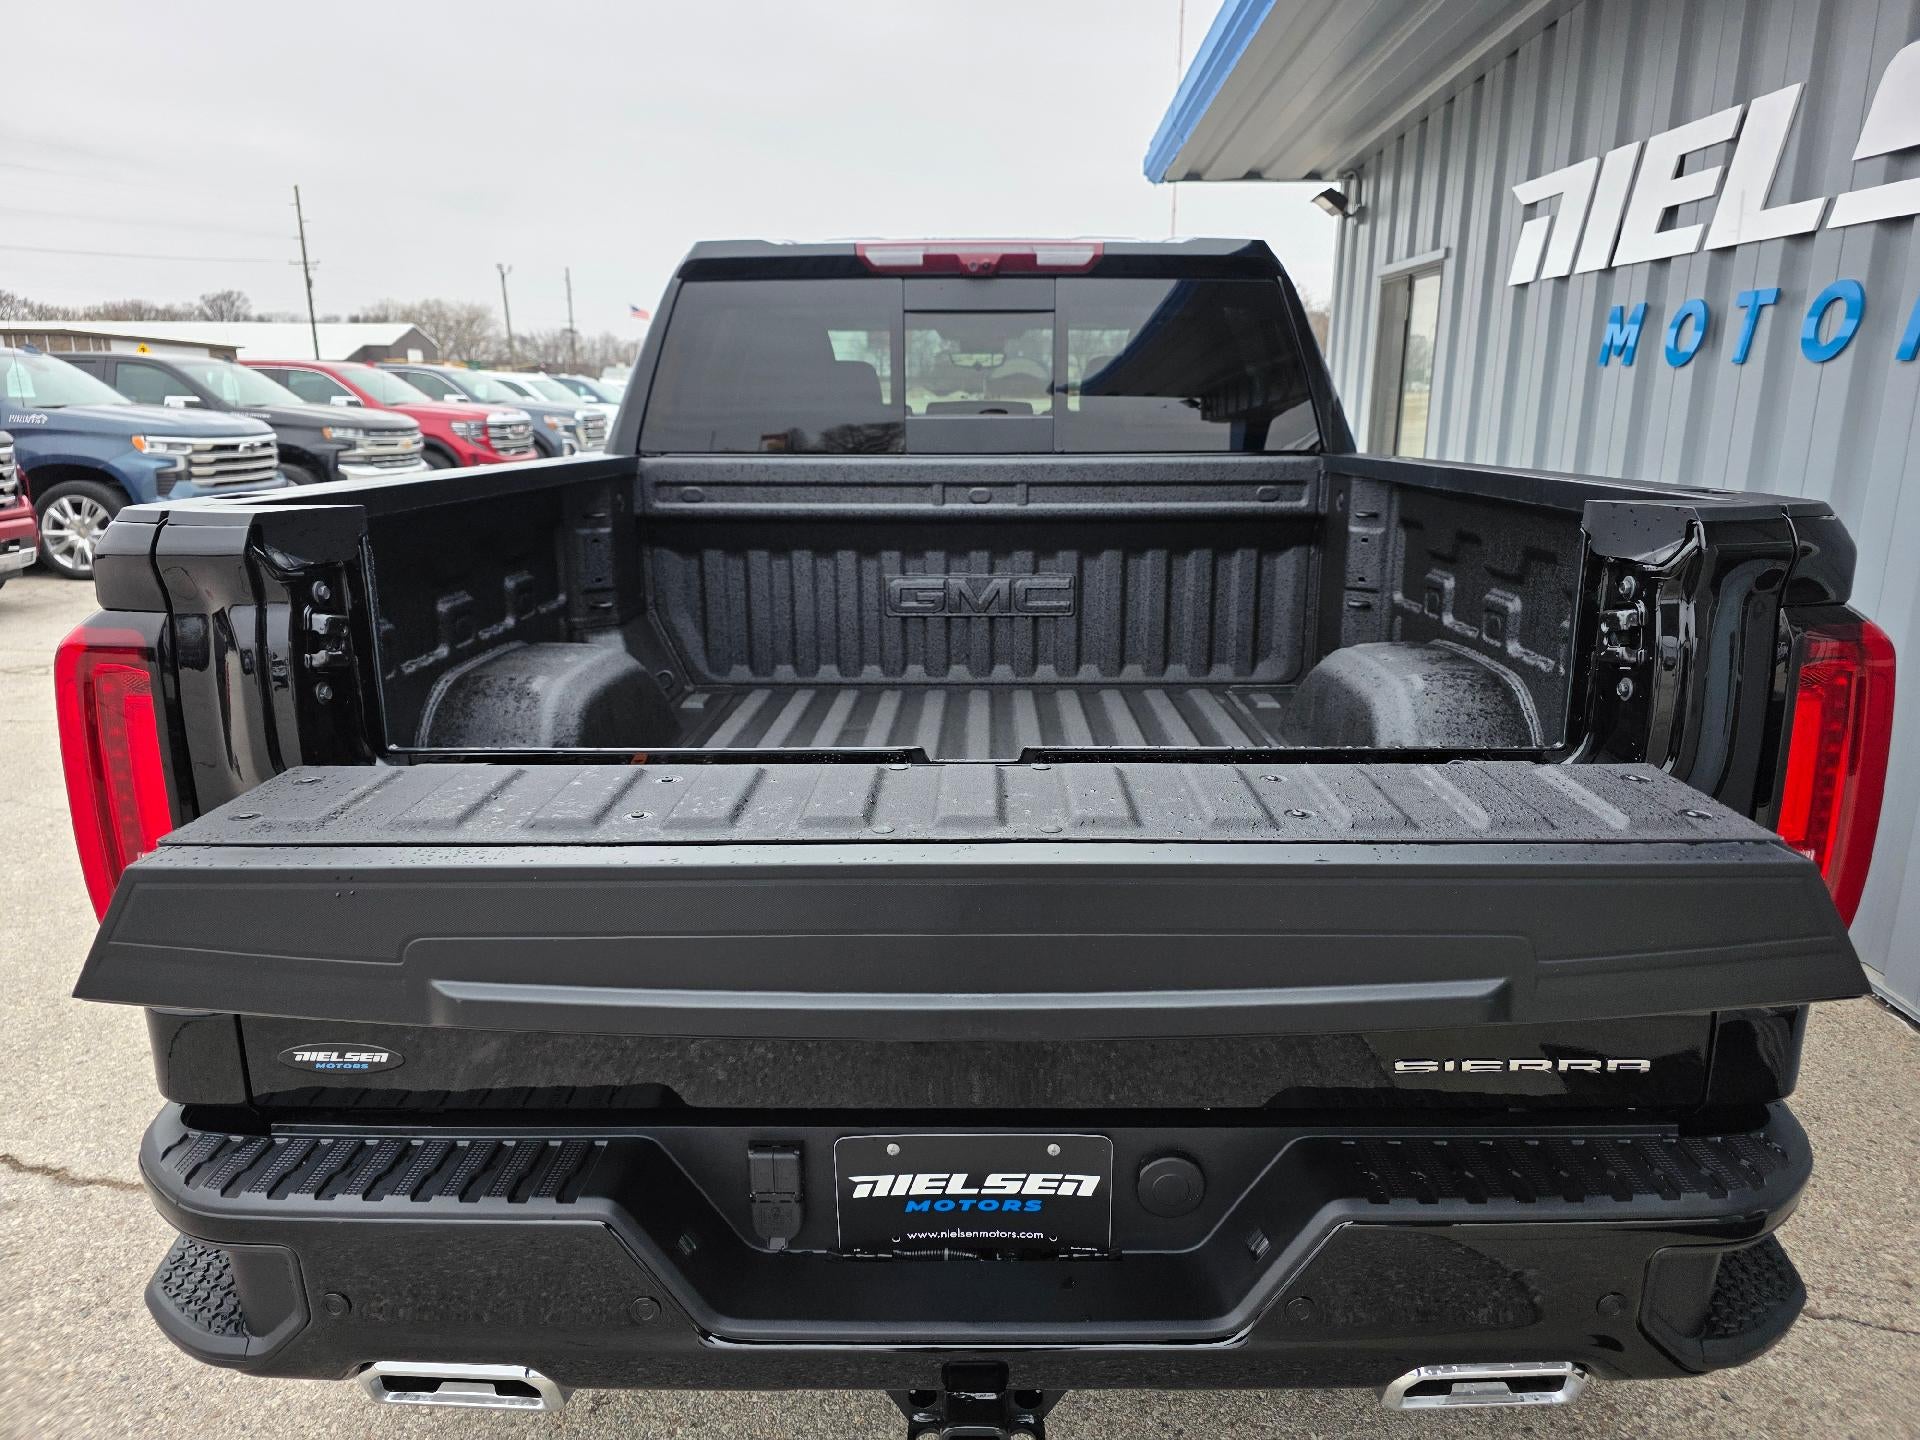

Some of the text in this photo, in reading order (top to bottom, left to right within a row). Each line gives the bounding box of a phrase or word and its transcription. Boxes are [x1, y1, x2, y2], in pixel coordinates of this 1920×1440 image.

[1598, 278, 1920, 368] MOTO
[889, 578, 1072, 614] GMC
[292, 1051, 389, 1063] NIELSEN
[314, 1062, 369, 1070] MOTORS
[1394, 1059, 1652, 1074] SIERRA
[848, 1173, 1101, 1199] NIELSEN
[904, 1199, 1043, 1214] MOTORS
[906, 1227, 1044, 1240] www.nielsenmotors.com
